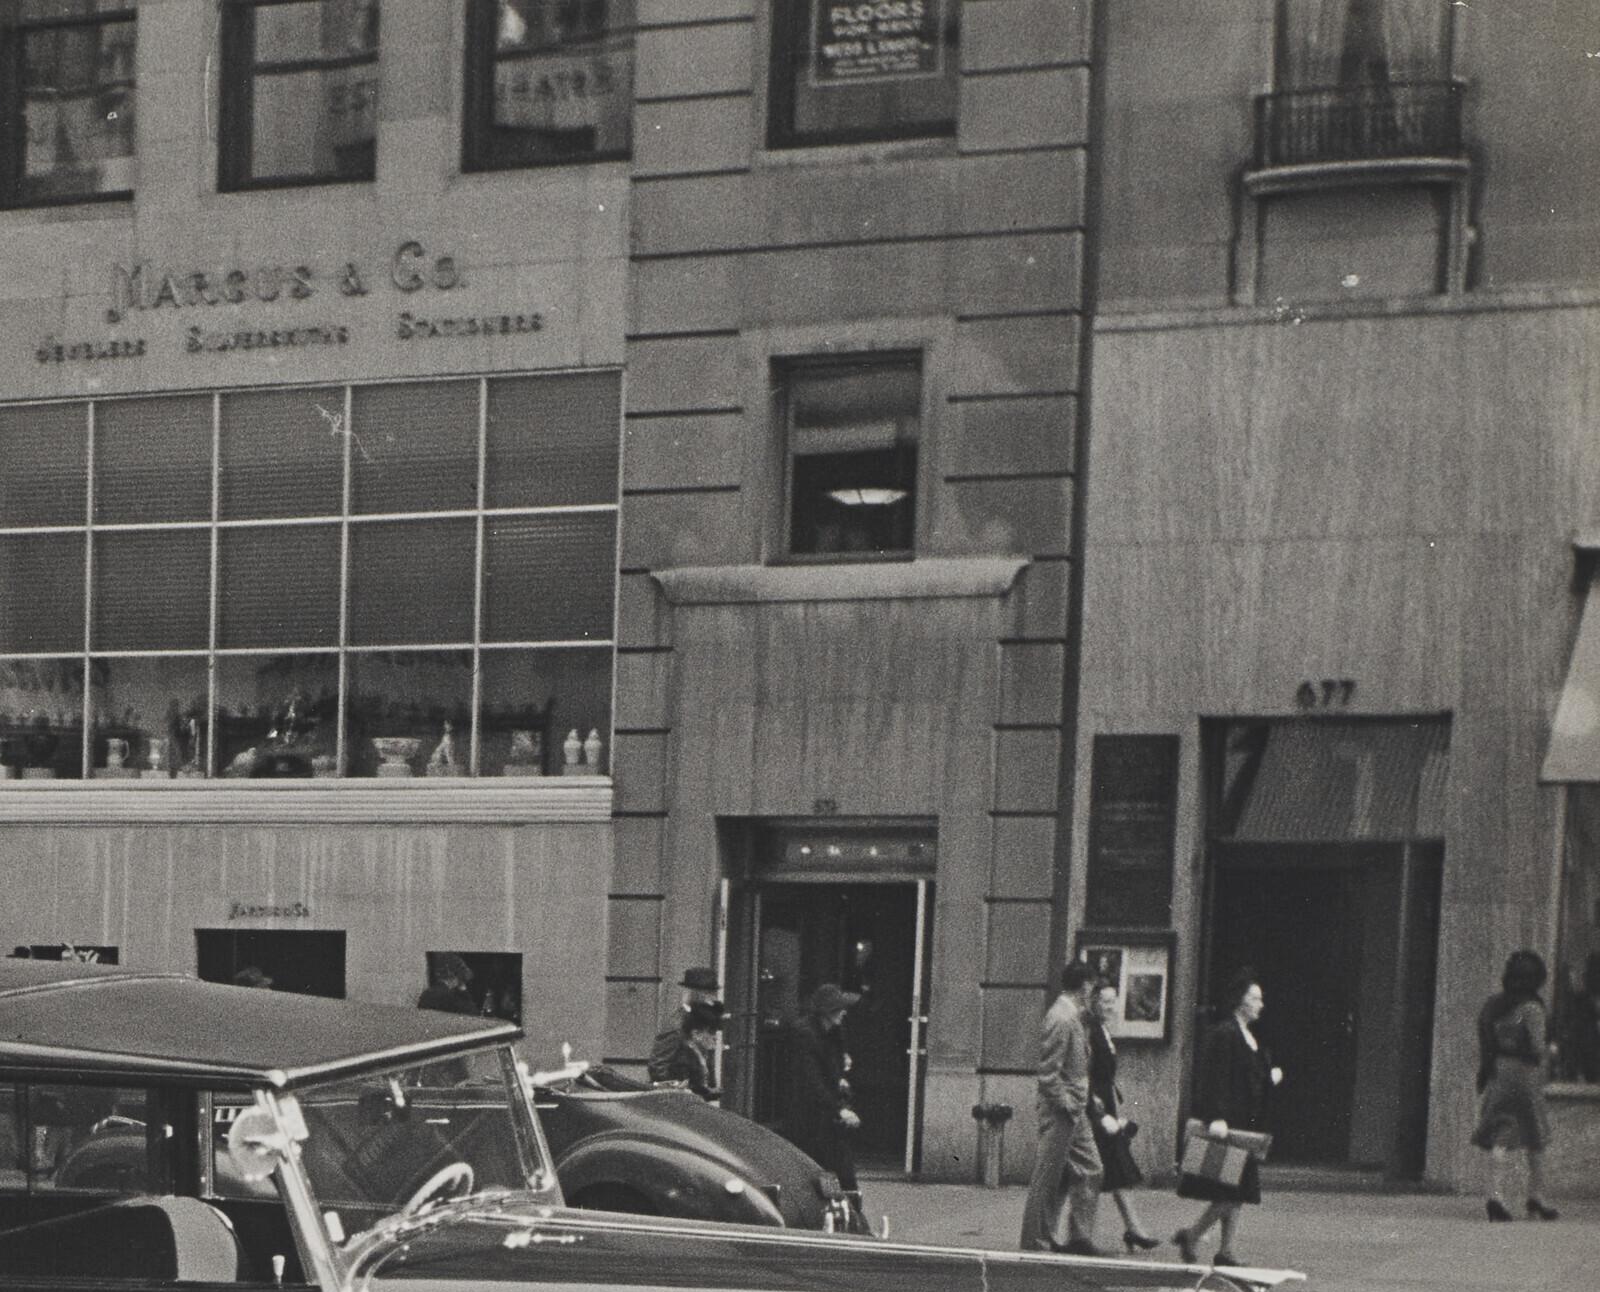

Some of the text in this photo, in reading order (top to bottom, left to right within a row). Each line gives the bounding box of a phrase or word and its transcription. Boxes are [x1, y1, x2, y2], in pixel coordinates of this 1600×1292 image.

[830, 0, 925, 23] FLOORS
[340, 261, 369, 298] &
[397, 311, 544, 341] STATIONERS
[1296, 679, 1358, 709] 677
